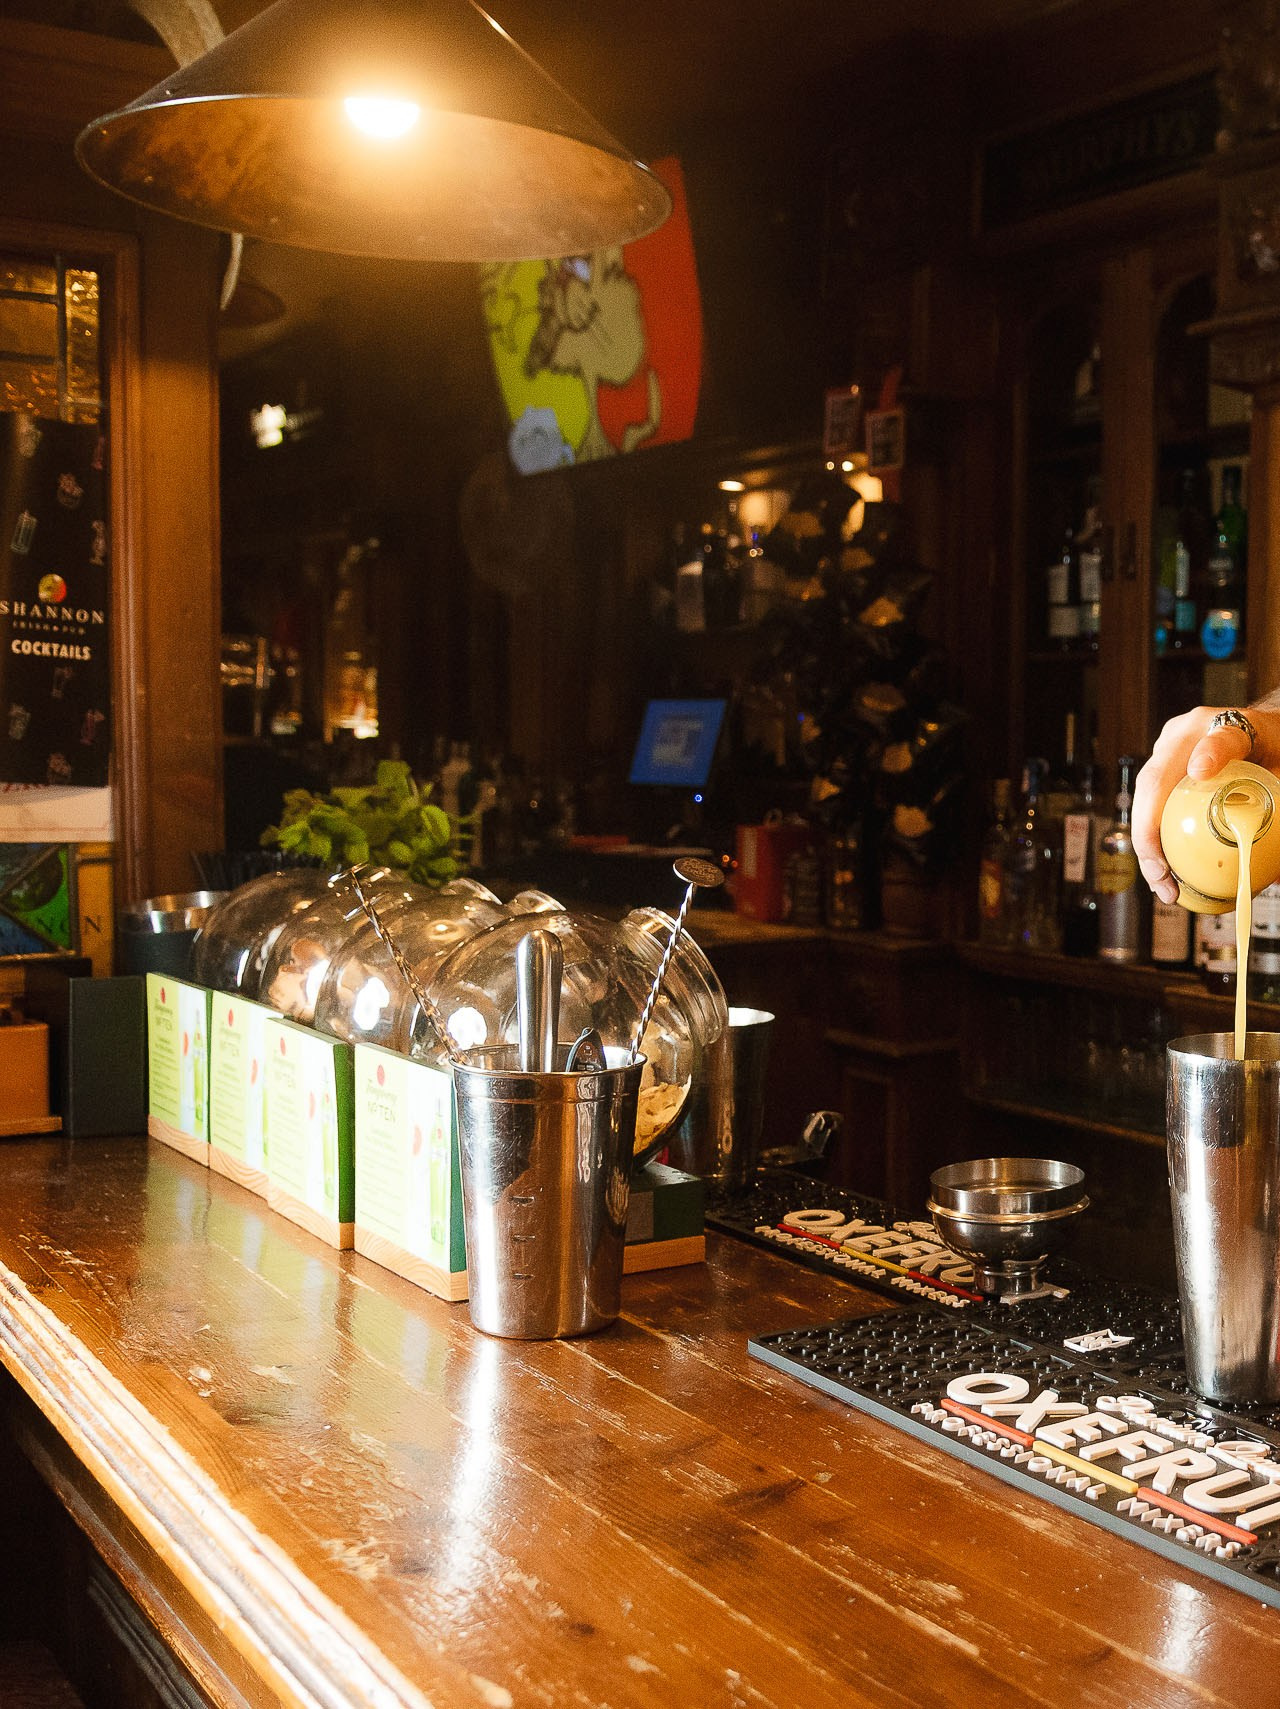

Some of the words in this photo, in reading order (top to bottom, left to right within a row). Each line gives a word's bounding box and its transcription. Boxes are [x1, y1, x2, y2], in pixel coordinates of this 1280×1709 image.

[0, 601, 105, 625] SHANNON
[11, 639, 91, 661] COCKTAILS
[890, 1276, 971, 1308] MIXERS
[910, 1401, 1107, 1500] PROFESSIONAL
[1115, 1496, 1243, 1559] MIXERS
